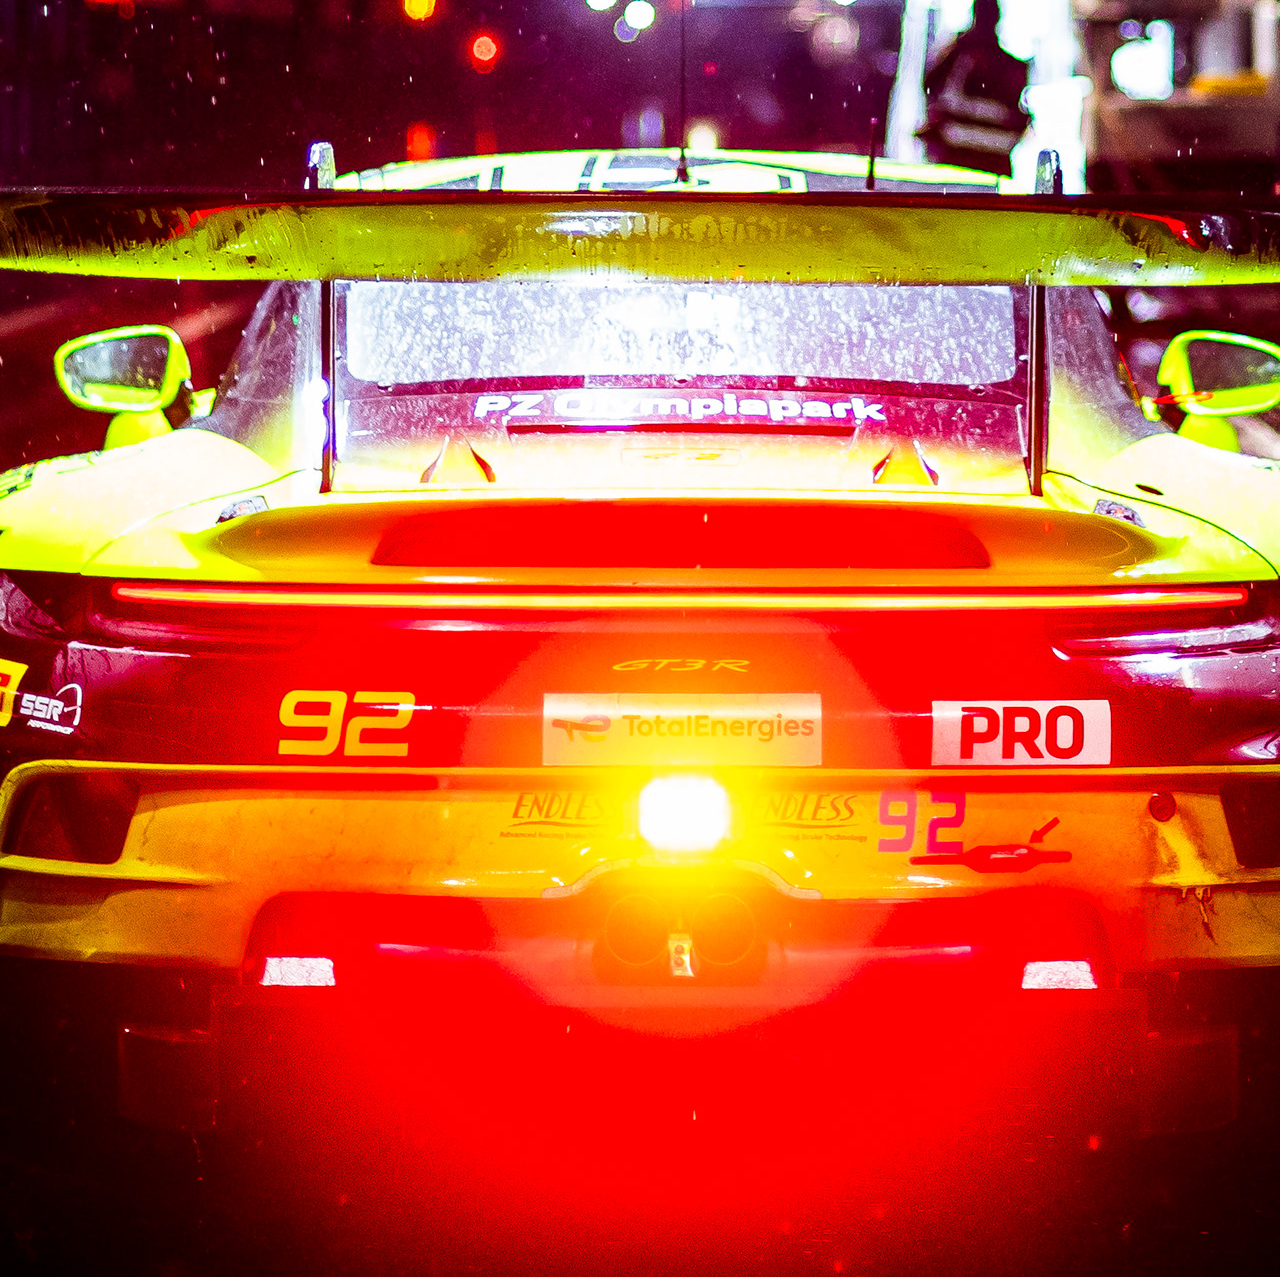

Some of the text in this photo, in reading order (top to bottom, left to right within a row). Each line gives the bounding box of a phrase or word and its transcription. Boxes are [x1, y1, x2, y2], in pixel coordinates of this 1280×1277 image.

[473, 395, 544, 419] PZ
[20, 692, 65, 722] SSR
[278, 690, 417, 756] 92
[621, 713, 815, 742] TotalEnergies
[960, 706, 1085, 759] PRO
[512, 791, 618, 820] ENDLESS
[878, 789, 967, 854] 92
